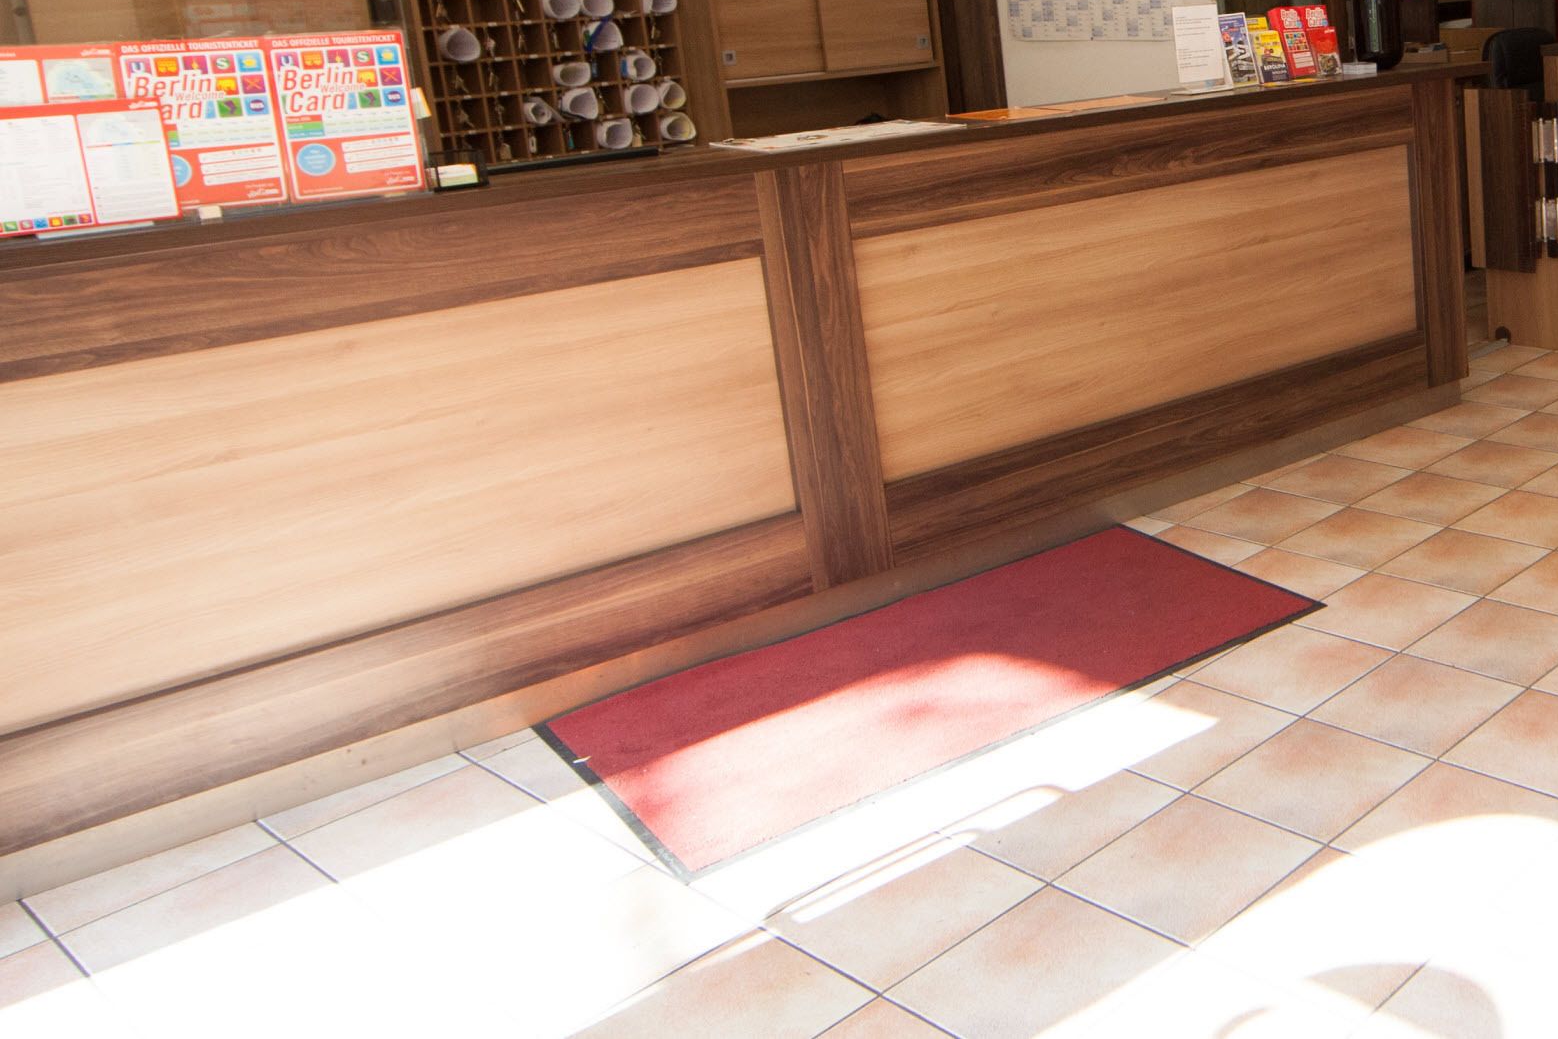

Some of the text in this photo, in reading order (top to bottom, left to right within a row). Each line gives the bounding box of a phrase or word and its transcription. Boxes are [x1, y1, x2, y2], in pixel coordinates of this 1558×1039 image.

[121, 45, 138, 53] DAS
[141, 43, 186, 52] OFFIZIELLE
[189, 40, 259, 51] TOURISTENTICKET
[272, 34, 396, 47] DAS OFFIZIELLE TOURISTENTICKET
[135, 74, 211, 98] Berlin
[283, 68, 353, 91] Berlin
[161, 100, 203, 120] ard
[289, 92, 345, 113] Card
